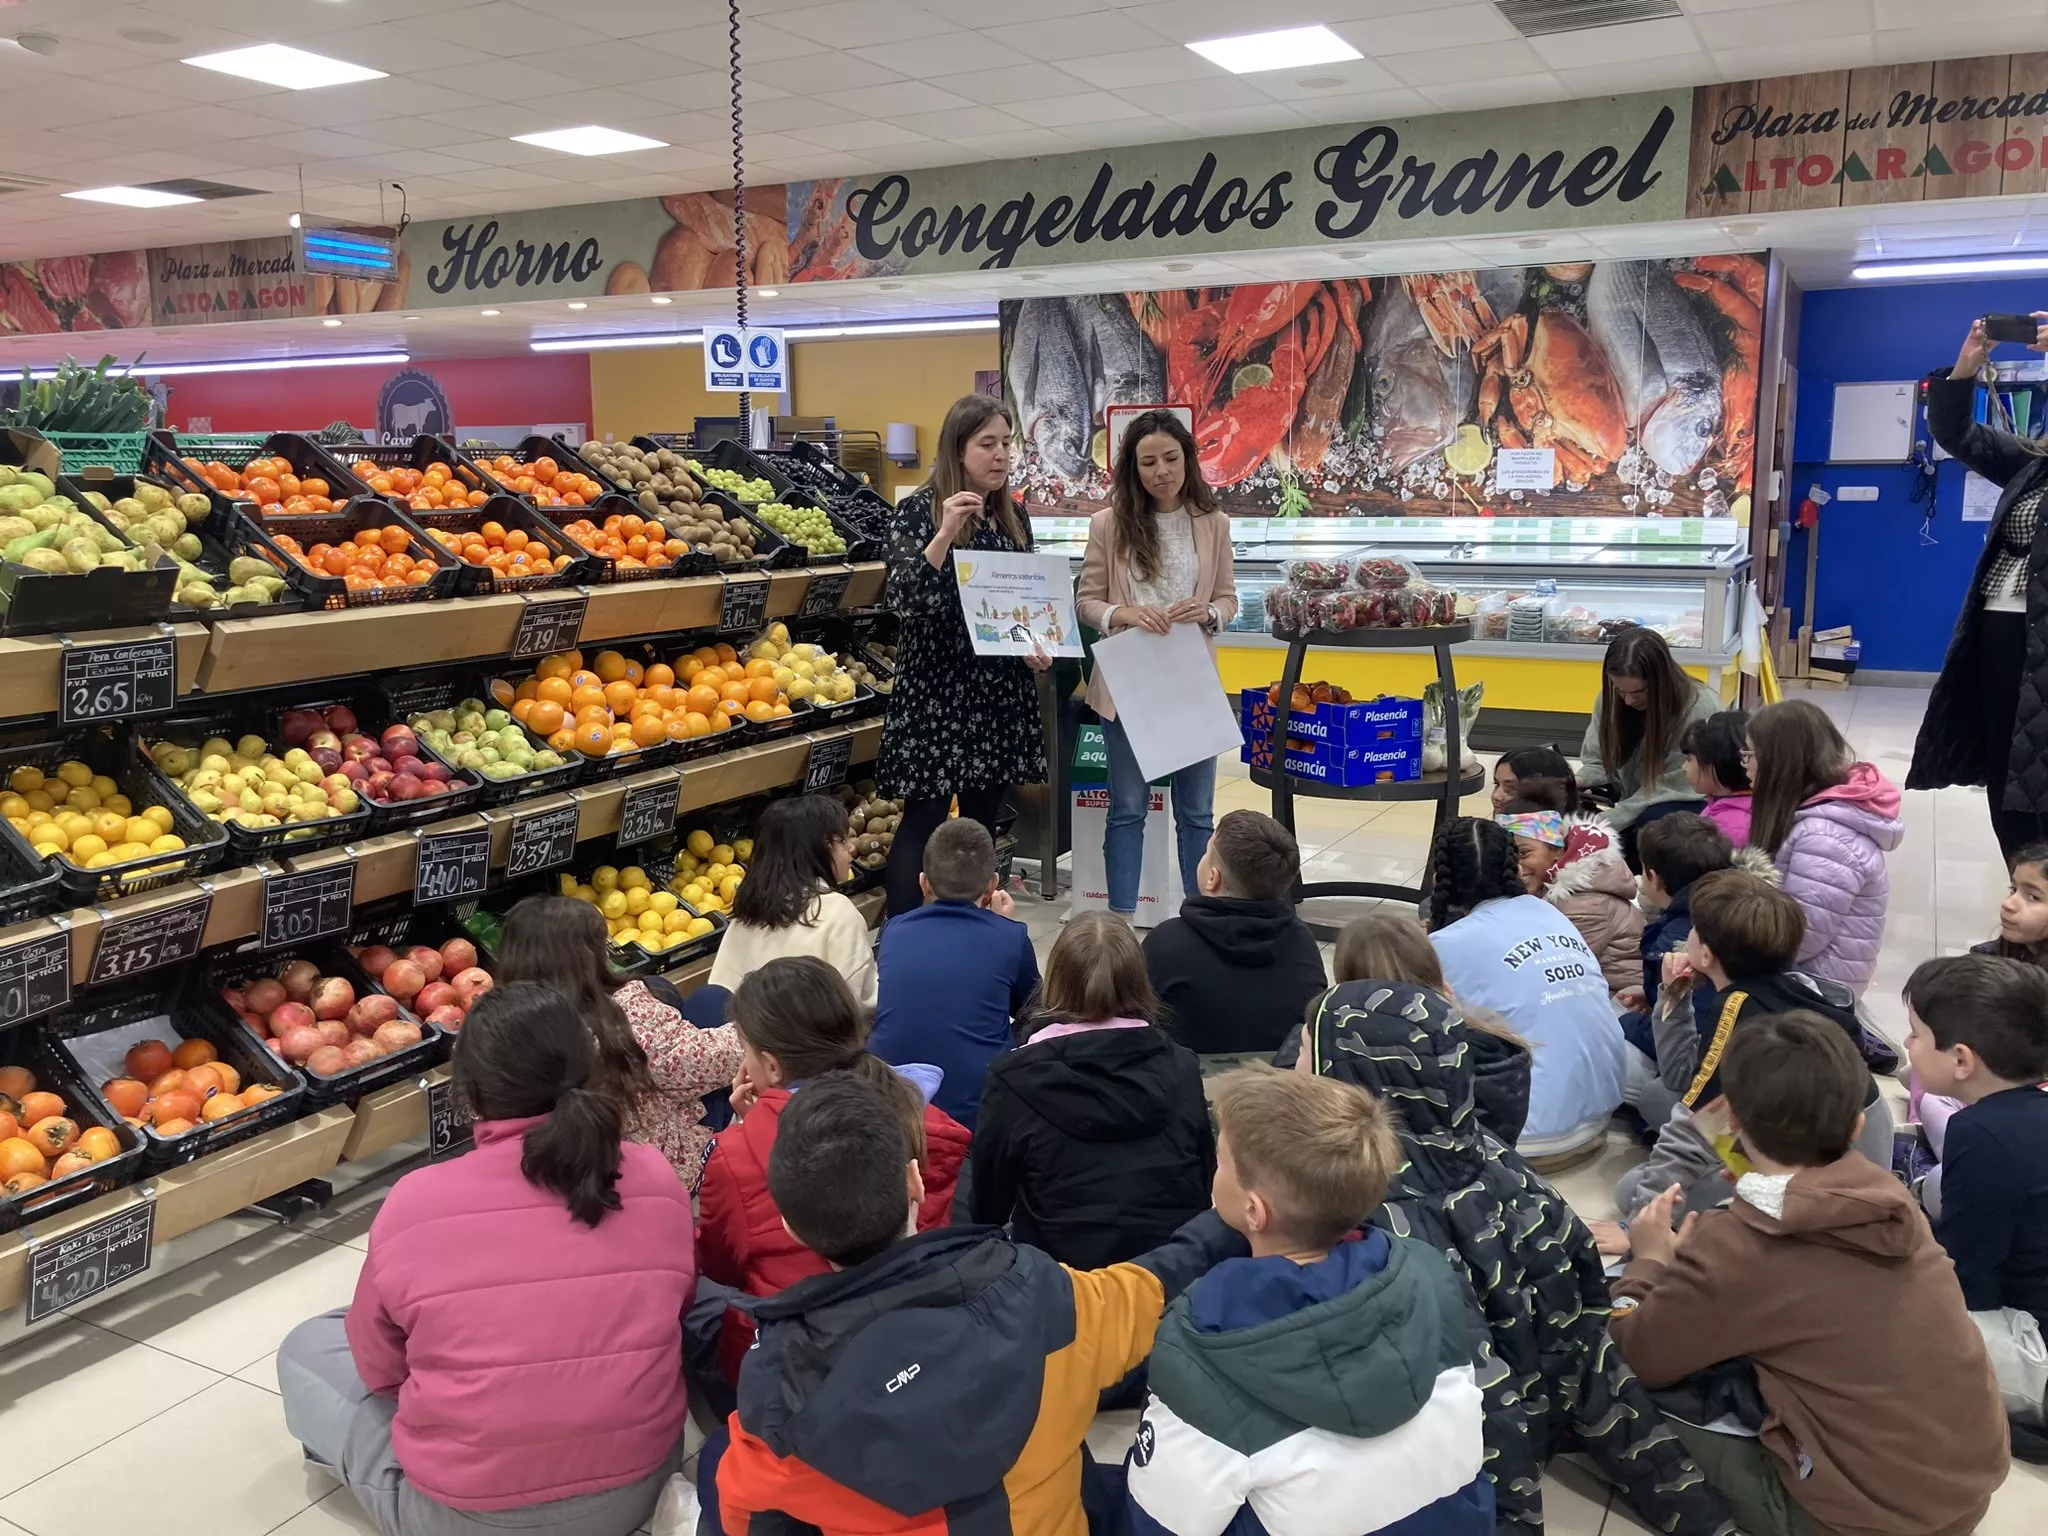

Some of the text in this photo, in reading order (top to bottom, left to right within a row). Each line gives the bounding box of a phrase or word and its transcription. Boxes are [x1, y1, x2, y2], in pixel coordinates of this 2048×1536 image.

[1711, 90, 2048, 145] Plaza del Mercad
[847, 106, 1676, 270] Congelados Granel
[427, 220, 603, 294] Horno
[161, 257, 210, 283] Plaza
[212, 267, 226, 278] del
[162, 280, 306, 315] ALTOARAGÓN
[147, 670, 168, 678] TECLA
[1365, 709, 1407, 722] Plasencia
[1083, 732, 1104, 744] De
[1287, 718, 1328, 738] asencia
[1081, 750, 1107, 762] aqu
[1363, 749, 1406, 763] Plasencia
[1285, 758, 1326, 777] asencia
[330, 892, 346, 900] TECLA
[1504, 935, 1590, 969] NEW YORK
[39, 965, 62, 977] TECLA
[1544, 963, 1584, 983] SOHO
[35, 1273, 58, 1286] P.V.P.
[120, 1233, 143, 1248] TECLA
[886, 1363, 921, 1393] CMP
